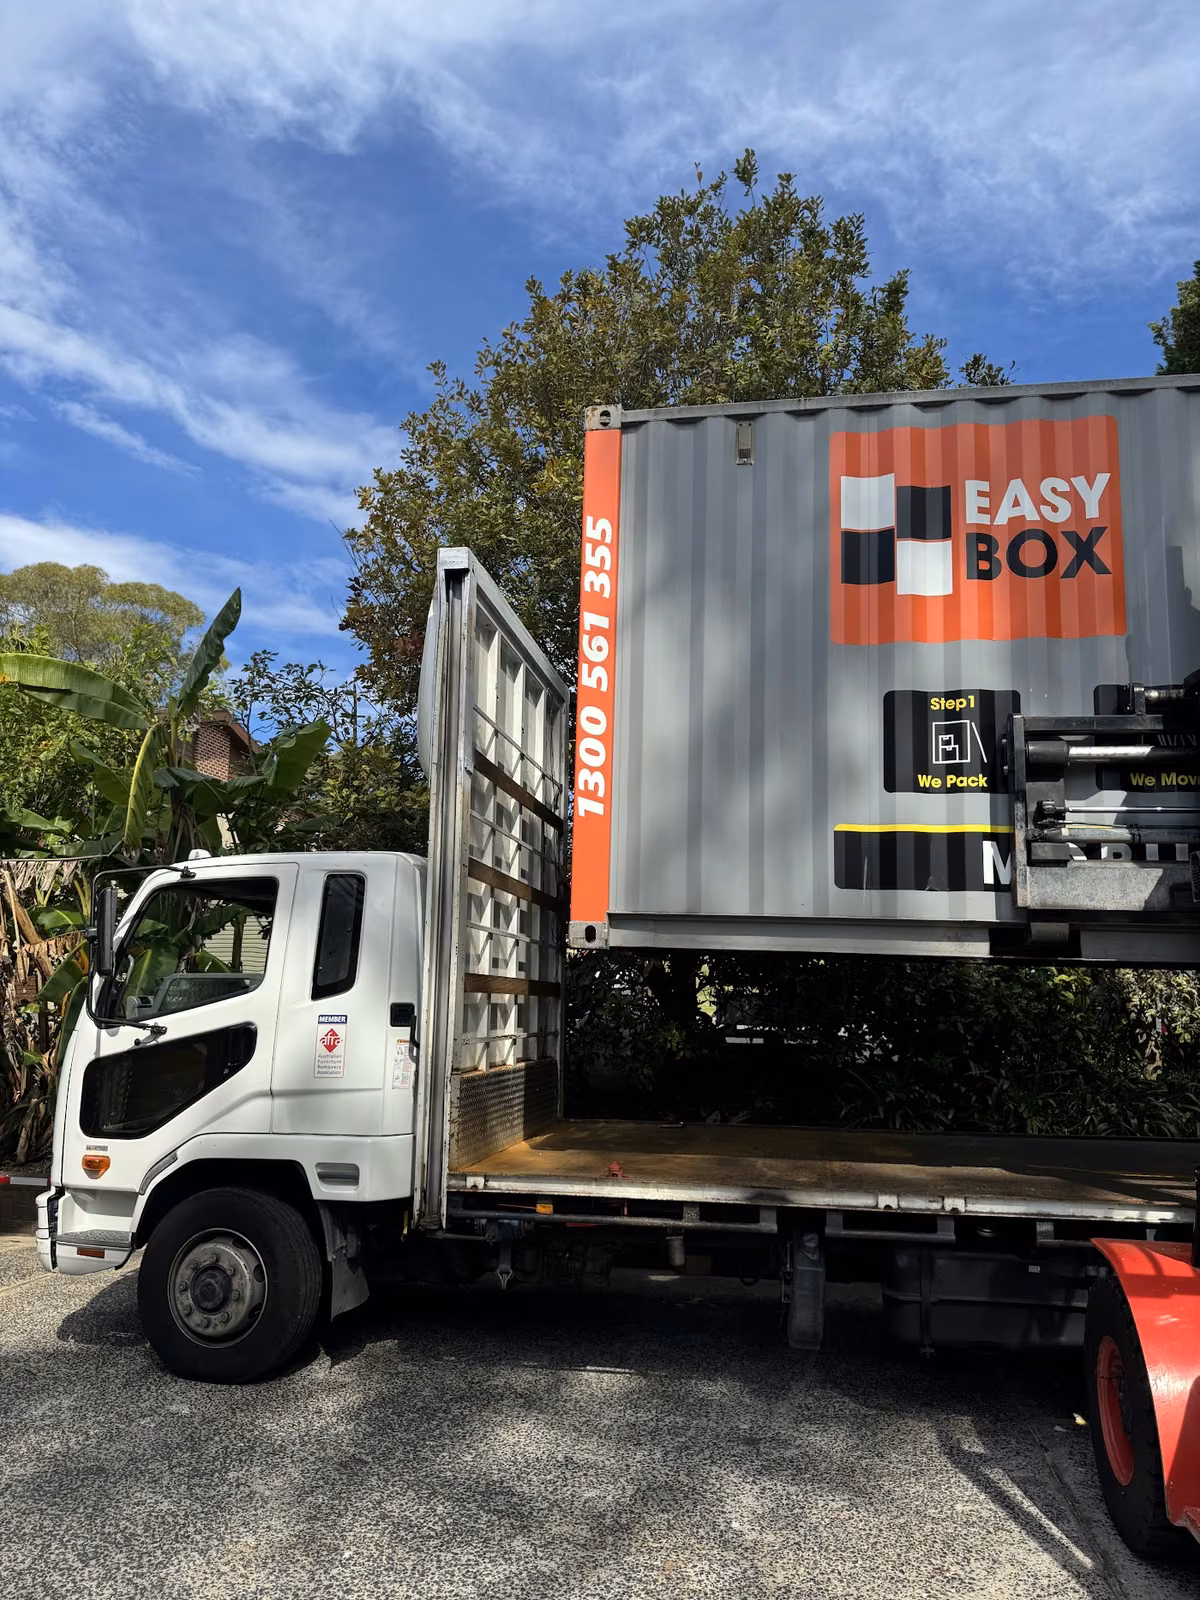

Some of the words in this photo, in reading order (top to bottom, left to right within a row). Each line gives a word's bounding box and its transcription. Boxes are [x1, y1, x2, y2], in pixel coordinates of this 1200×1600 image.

[965, 473, 1111, 525] EASY
[584, 515, 613, 599] 355
[966, 526, 1112, 580] BOX
[582, 611, 610, 693] 561
[577, 705, 608, 817] 1300
[918, 774, 942, 788] We
[946, 773, 988, 788] Pack
[1130, 772, 1156, 786] We
[320, 1032, 342, 1046] afra
